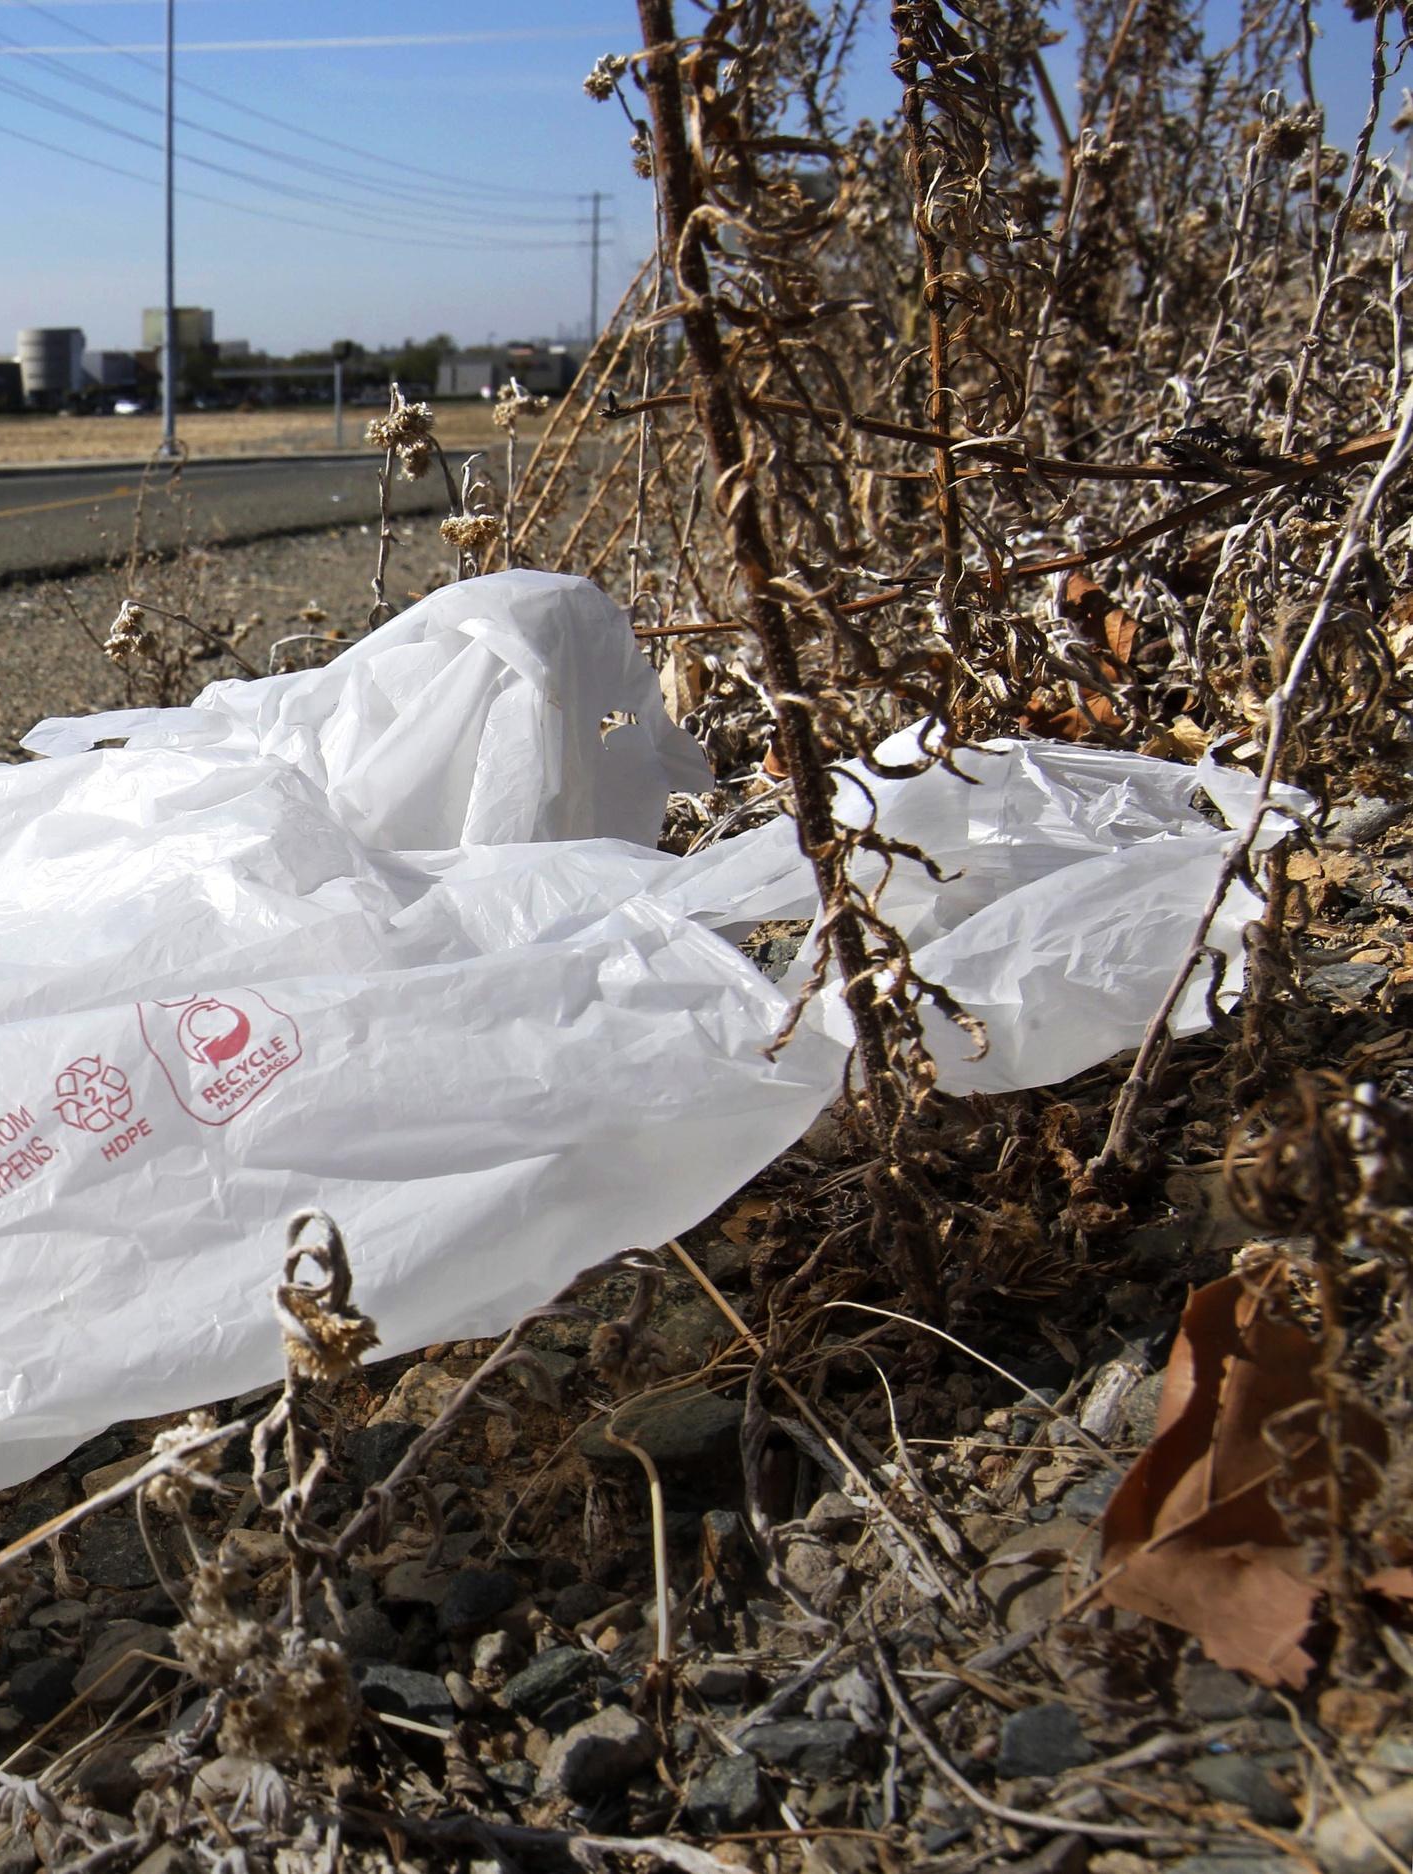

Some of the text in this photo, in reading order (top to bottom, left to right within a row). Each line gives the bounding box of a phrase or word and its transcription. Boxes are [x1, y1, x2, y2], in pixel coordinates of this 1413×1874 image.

[201, 1036, 288, 1104] RECYCLE
[216, 1054, 290, 1111] PLASTIC BAGS
[83, 1086, 104, 1107] 2
[100, 1118, 153, 1162] HDPE
